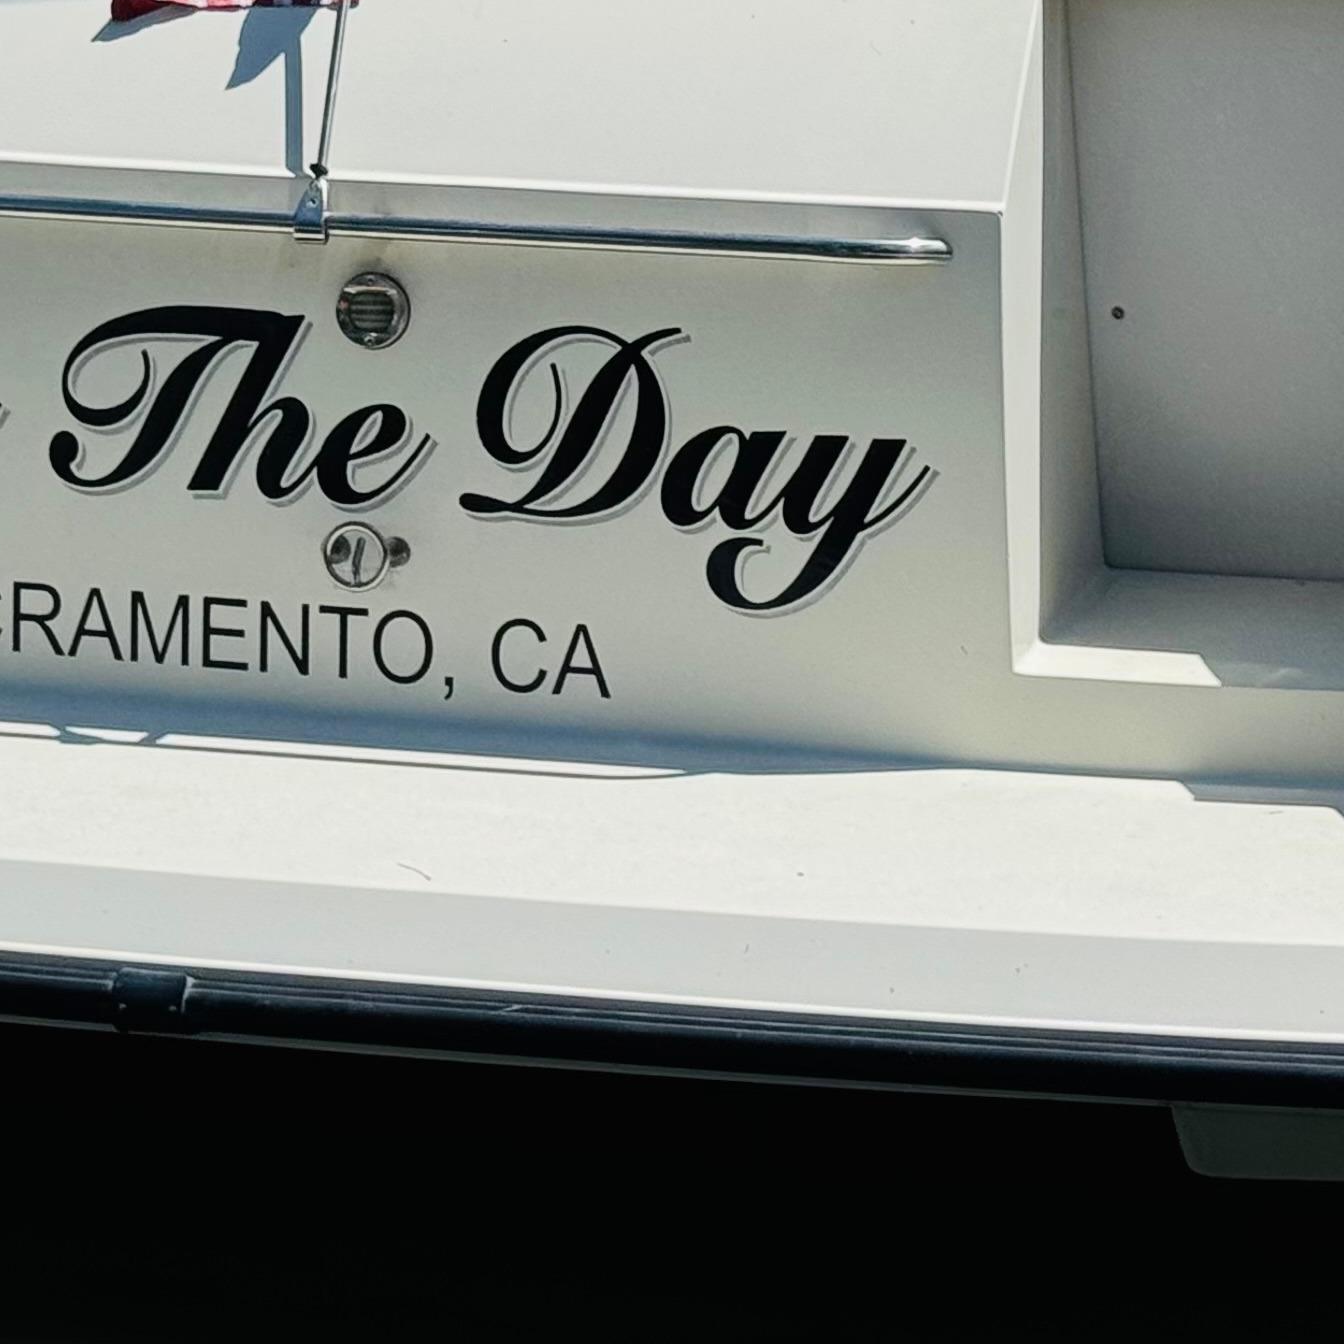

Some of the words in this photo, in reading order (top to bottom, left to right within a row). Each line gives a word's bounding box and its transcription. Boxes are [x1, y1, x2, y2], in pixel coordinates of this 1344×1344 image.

[49, 305, 436, 510] The
[459, 325, 938, 618] Day
[491, 618, 612, 700] CA
